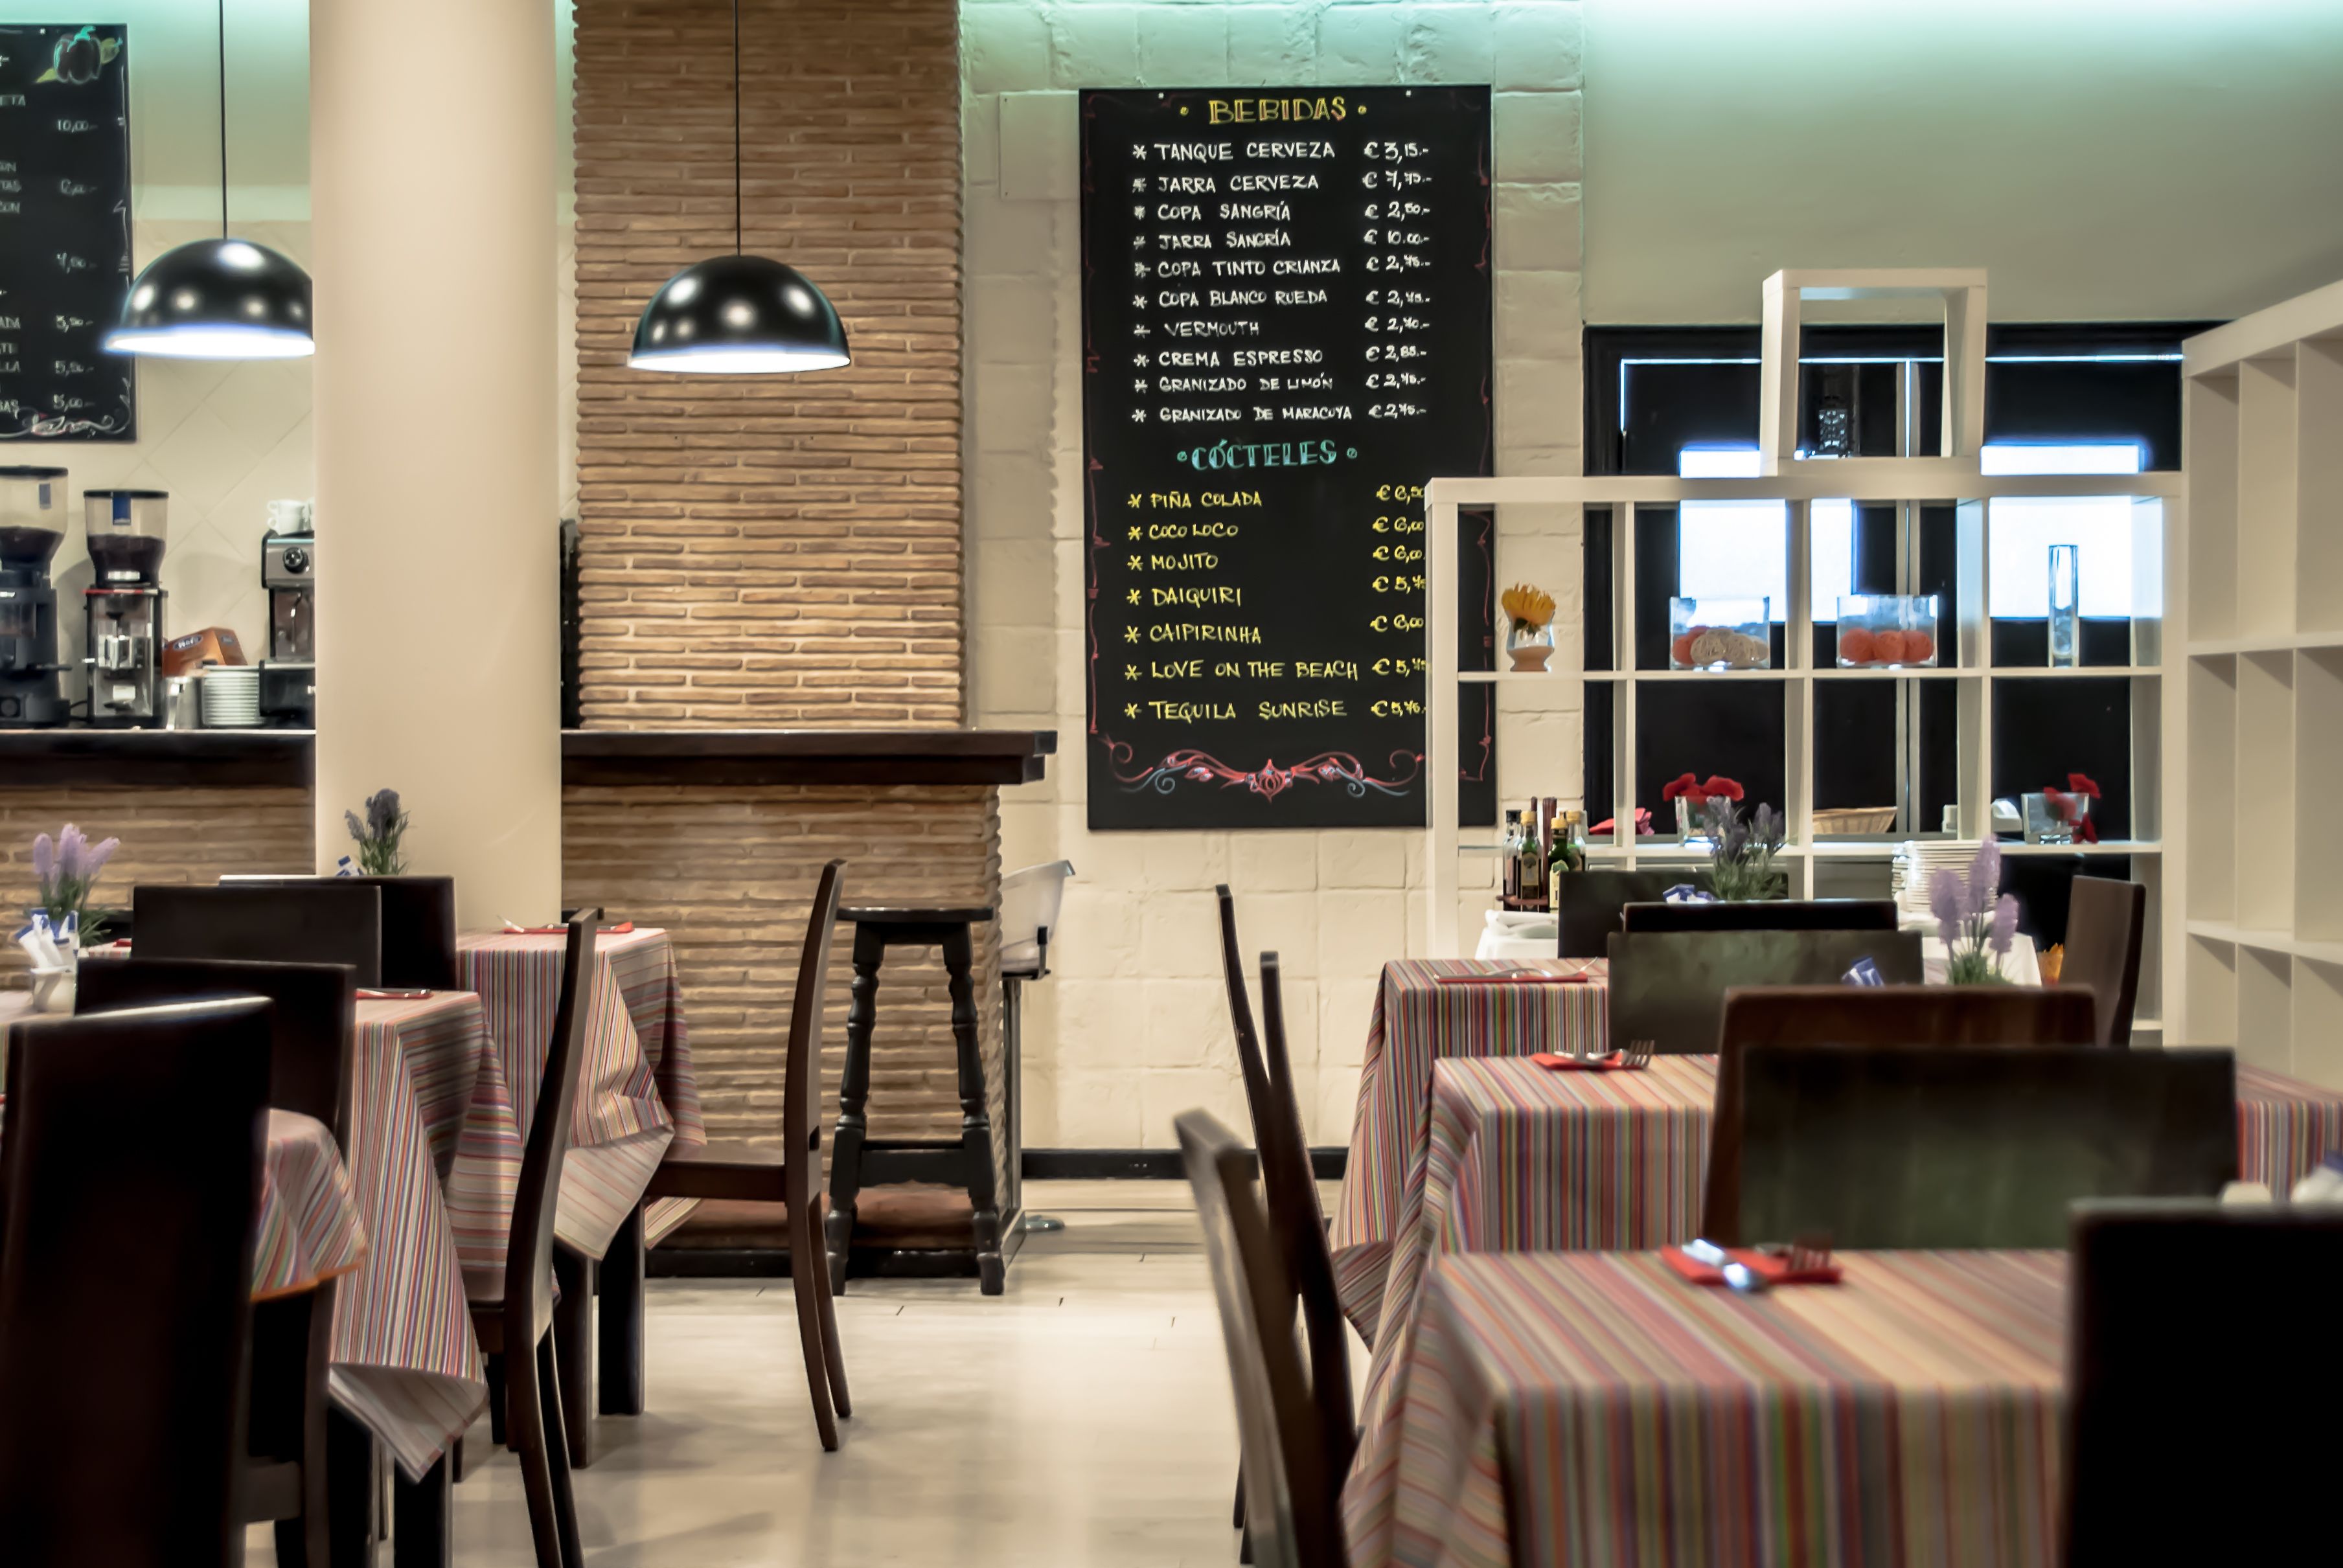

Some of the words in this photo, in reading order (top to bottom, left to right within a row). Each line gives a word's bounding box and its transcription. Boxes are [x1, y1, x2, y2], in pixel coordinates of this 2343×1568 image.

[1208, 96, 1347, 125] BEBIDAS
[1153, 142, 1233, 164] TANQUE
[1246, 141, 1335, 159] CERVEZA
[1158, 176, 1217, 195] JARRA
[1229, 174, 1319, 192] CERVEZA
[1157, 203, 1202, 221] COPA
[1219, 200, 1291, 221] SANGRÍA
[1158, 234, 1212, 250] JARRA
[1226, 227, 1291, 249] SANGRÍA
[1157, 260, 1202, 278] COPA
[1211, 260, 1266, 277] TINTO
[1272, 258, 1341, 275] CRIANZA
[1158, 290, 1199, 308] COPA
[1209, 290, 1267, 307] BLANCO
[1275, 289, 1327, 306] RUEDA
[1163, 321, 1259, 337] VERMOUTH
[1158, 351, 1220, 368] CREMA
[1233, 348, 1323, 367] ESPRESSO
[1159, 376, 1247, 392] GRANIZADO
[1259, 378, 1280, 391] DE
[1286, 372, 1333, 390] LIMÓN
[1159, 407, 1242, 424] GRANIZADO
[1253, 406, 1274, 422] DE
[1282, 405, 1353, 420] MARACUYA
[1191, 438, 1337, 470] CÓCTELES
[1150, 490, 1192, 509] PIÑA
[1200, 491, 1262, 507] COLADA
[1149, 524, 1187, 540] COCO
[1192, 522, 1239, 538] LOCO
[1151, 552, 1218, 571] MOJITO
[1151, 586, 1241, 609] DAIQUIRI
[1149, 622, 1262, 644] CAIPIRINHA
[1151, 659, 1204, 679] LOVE
[1215, 662, 1240, 678] ON
[1246, 661, 1286, 678] THE
[1295, 660, 1358, 681] BEACH
[1148, 700, 1237, 724] TEQUILA
[1259, 699, 1347, 721] SUNRISE
